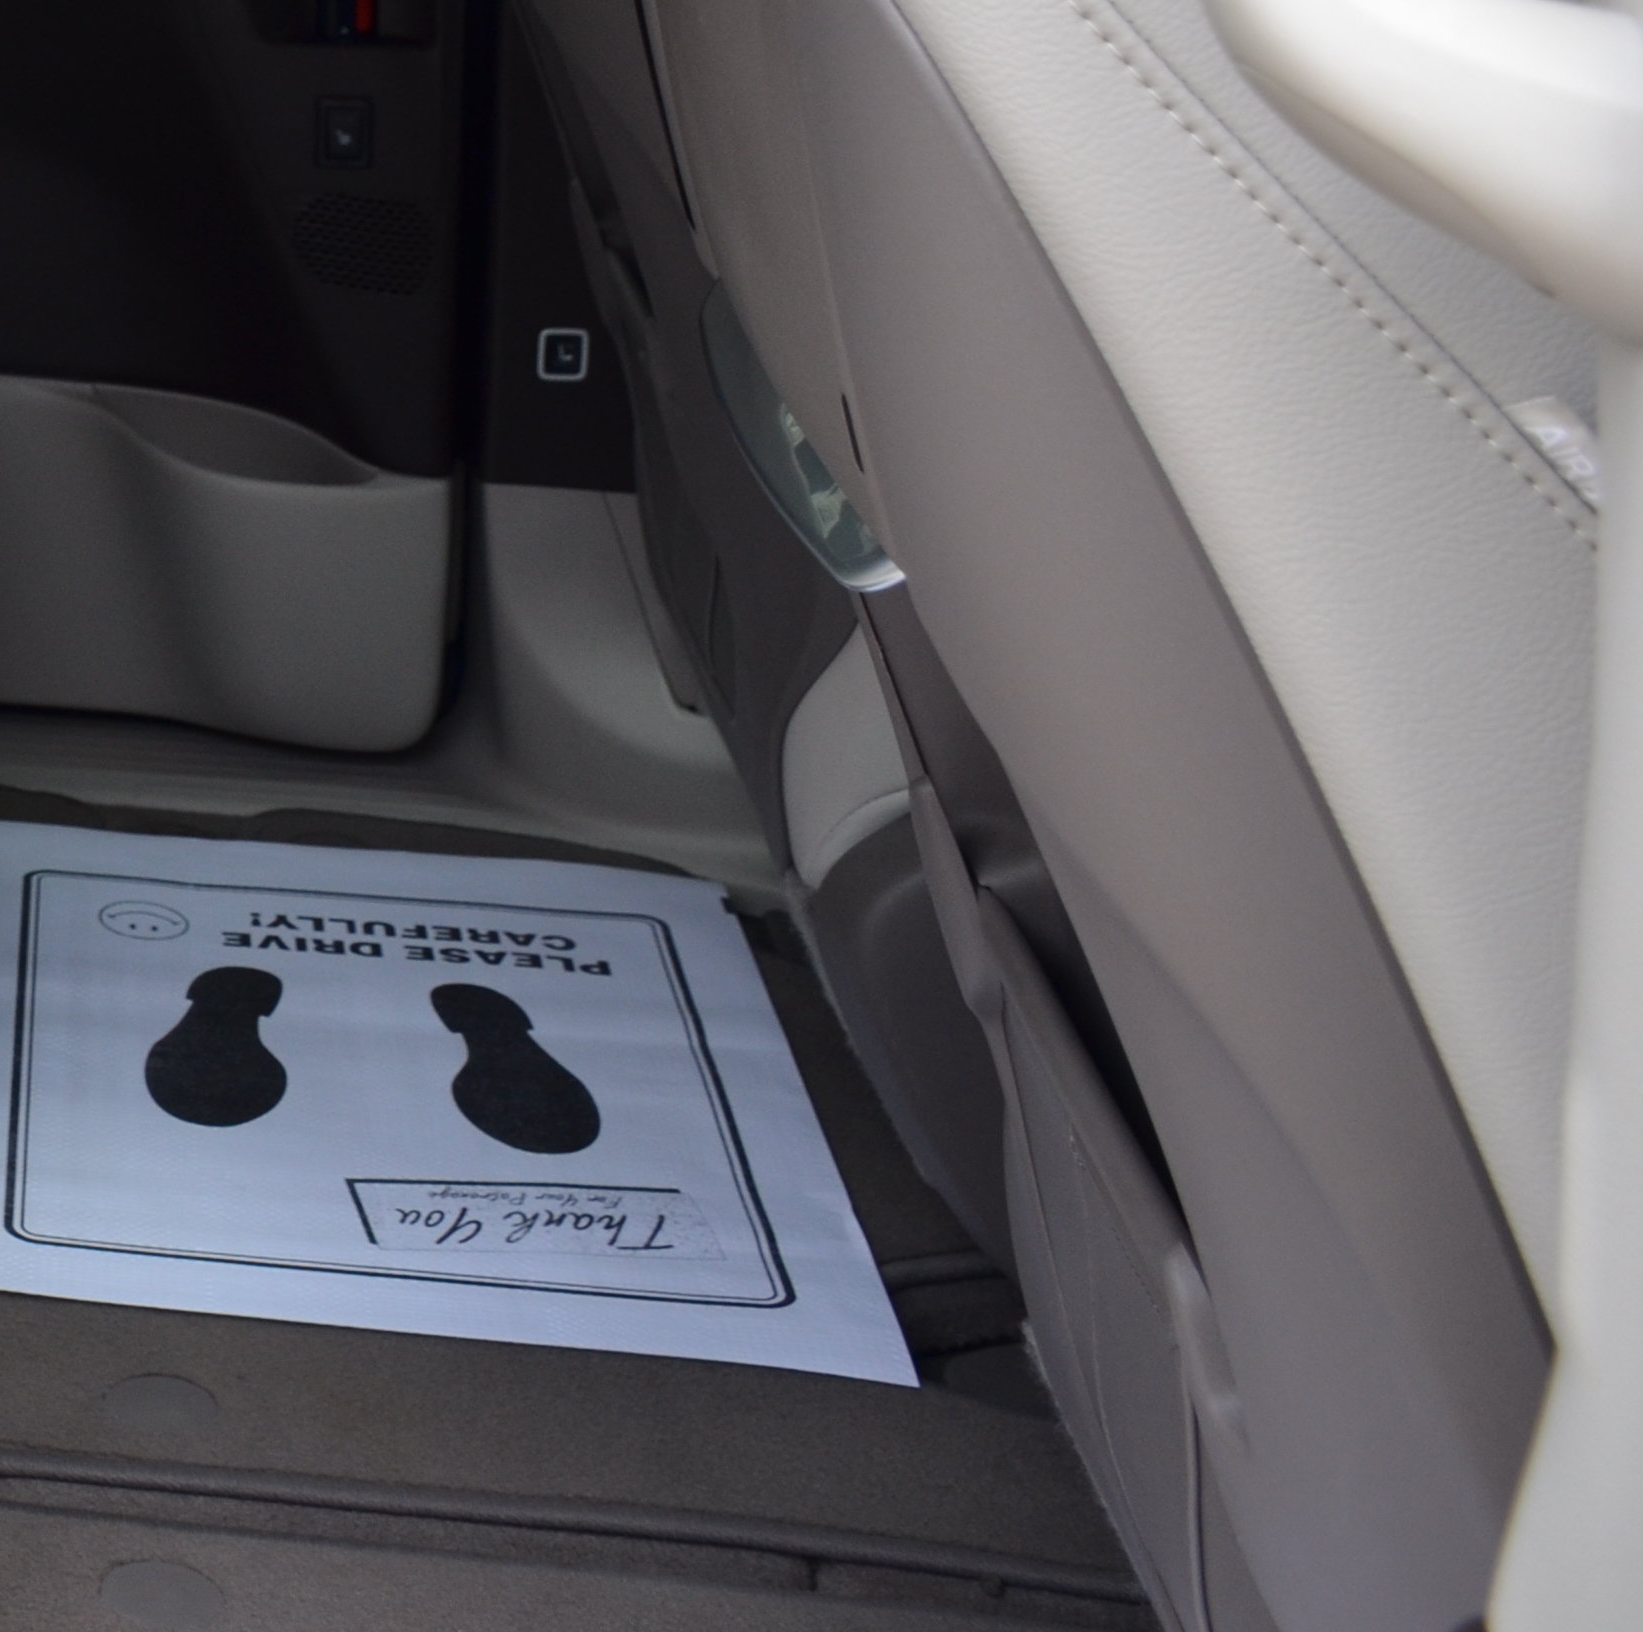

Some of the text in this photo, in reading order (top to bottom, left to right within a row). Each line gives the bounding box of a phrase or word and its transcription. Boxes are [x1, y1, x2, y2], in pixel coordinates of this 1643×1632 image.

[221, 930, 614, 977] PLEASE DRIVE
[249, 911, 578, 952] CAREFULLY!
[394, 1206, 675, 1251] Thank You
